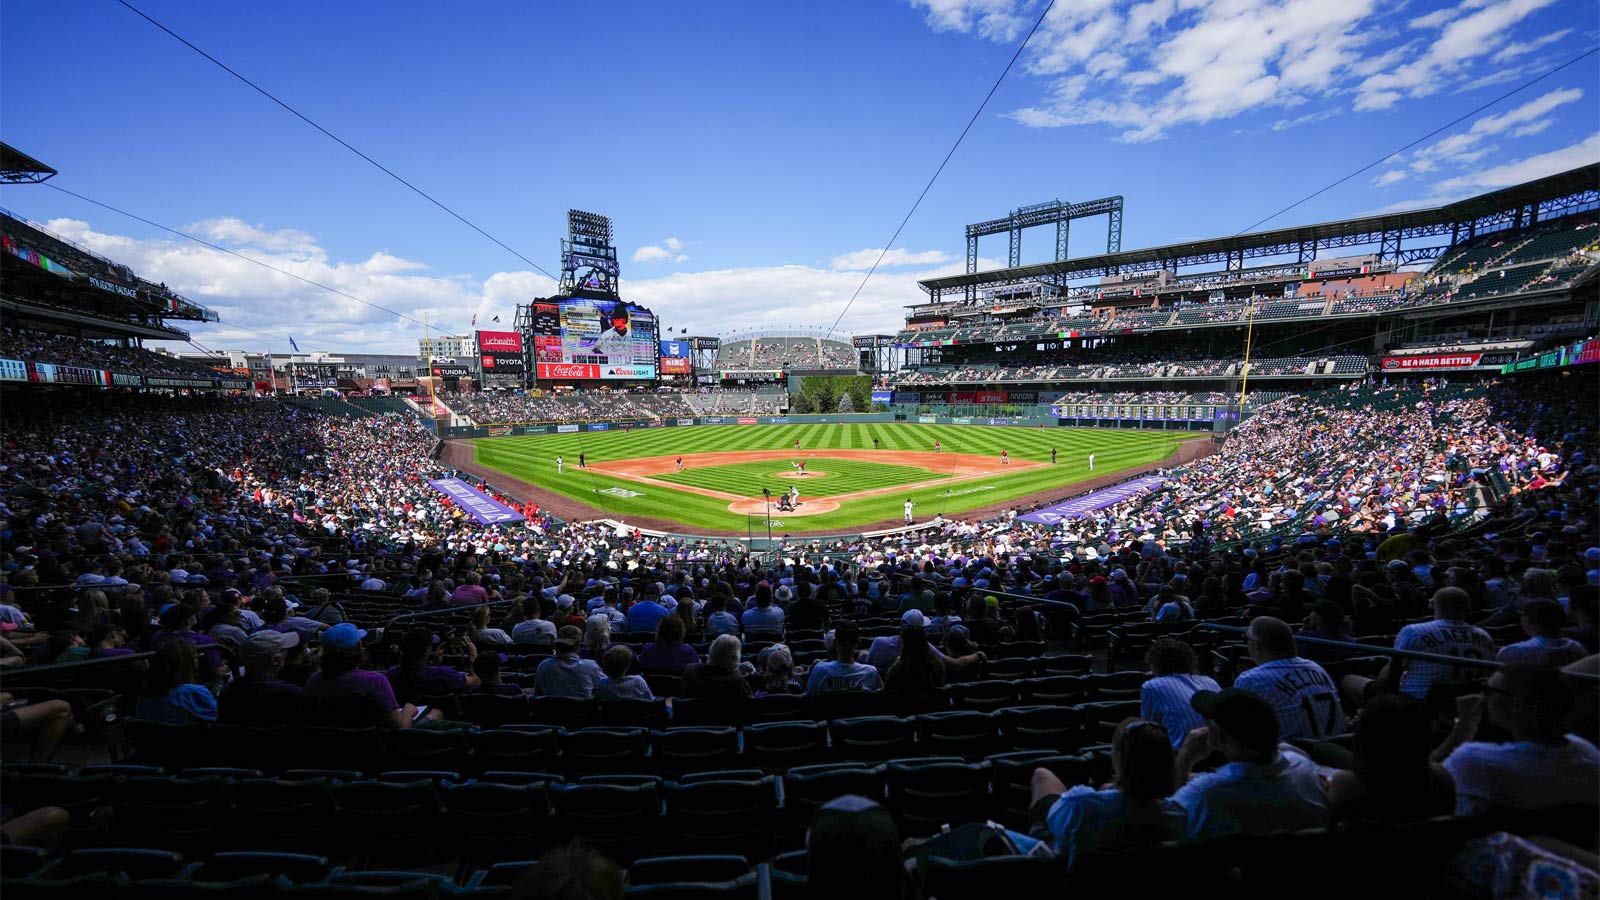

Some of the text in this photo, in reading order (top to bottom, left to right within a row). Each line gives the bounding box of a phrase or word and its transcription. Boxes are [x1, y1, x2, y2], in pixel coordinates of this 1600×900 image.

[115, 285, 137, 298] SAUSAGE
[485, 336, 516, 345] uchealth
[666, 358, 685, 366] KING
[1402, 359, 1412, 367] BE
[1419, 358, 1439, 366] HAIR
[1439, 357, 1472, 365] BETTER
[441, 368, 467, 376] TUNDRA
[615, 367, 634, 376] Coors
[1275, 668, 1333, 695] HELTON
[1302, 693, 1336, 737] 17
